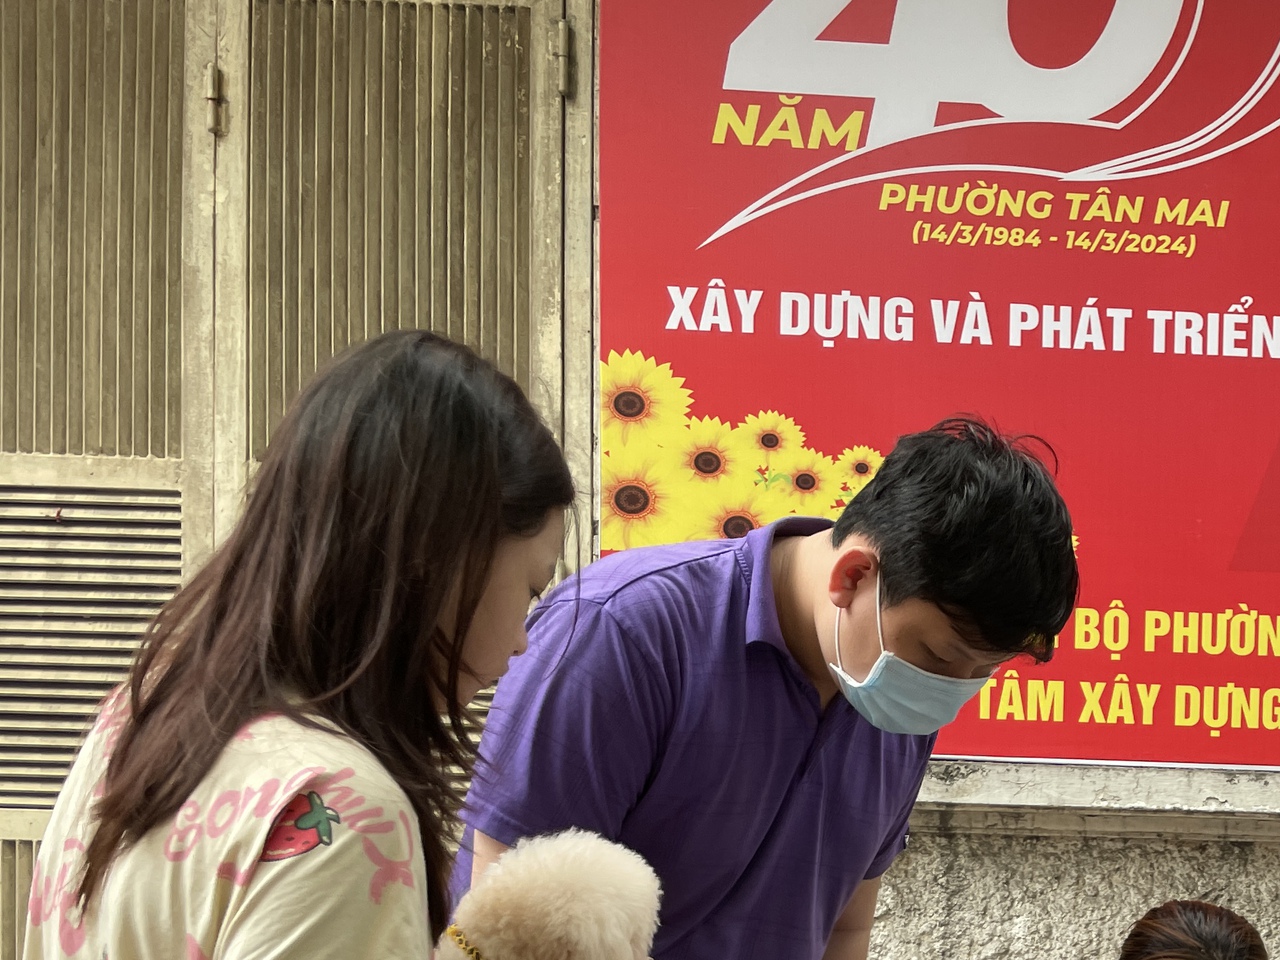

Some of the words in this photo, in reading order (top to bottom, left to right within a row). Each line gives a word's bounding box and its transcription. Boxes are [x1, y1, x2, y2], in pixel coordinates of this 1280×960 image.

[711, 94, 865, 152] NĂM
[878, 179, 1055, 219] PHƯỜNG
[1065, 186, 1145, 224] TÂN
[1153, 197, 1230, 228] MAI
[912, 220, 1042, 248] (14/3/1984
[1065, 228, 1198, 258] 14/3/2024)
[664, 277, 764, 334] XÂY
[779, 289, 914, 348] DỰNG
[929, 291, 993, 346] VÀ
[1008, 297, 1133, 353] PHÁT
[1074, 599, 1130, 661] BỘ
[979, 669, 1065, 723] TÂM
[1077, 673, 1162, 726] XÂY
